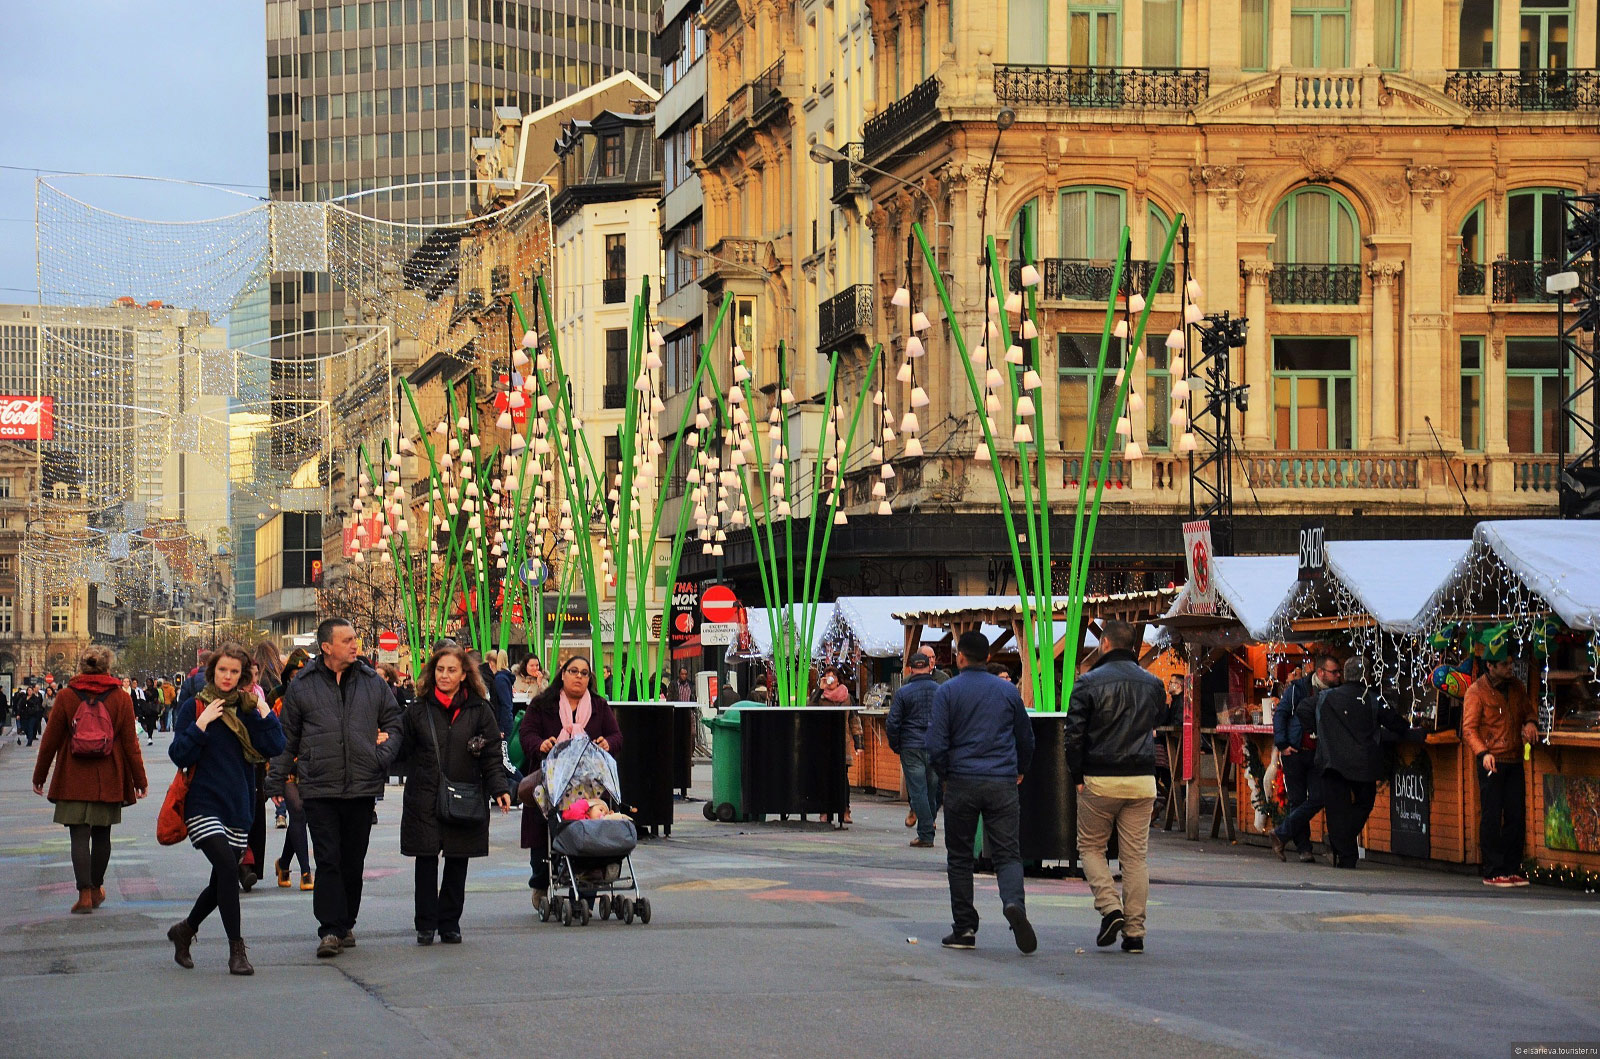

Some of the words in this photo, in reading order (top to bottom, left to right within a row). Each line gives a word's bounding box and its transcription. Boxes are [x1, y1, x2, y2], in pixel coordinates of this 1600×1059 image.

[1, 427, 25, 435] COLD
[671, 593, 698, 606] WOK
[1395, 773, 1424, 802] BAGELS
